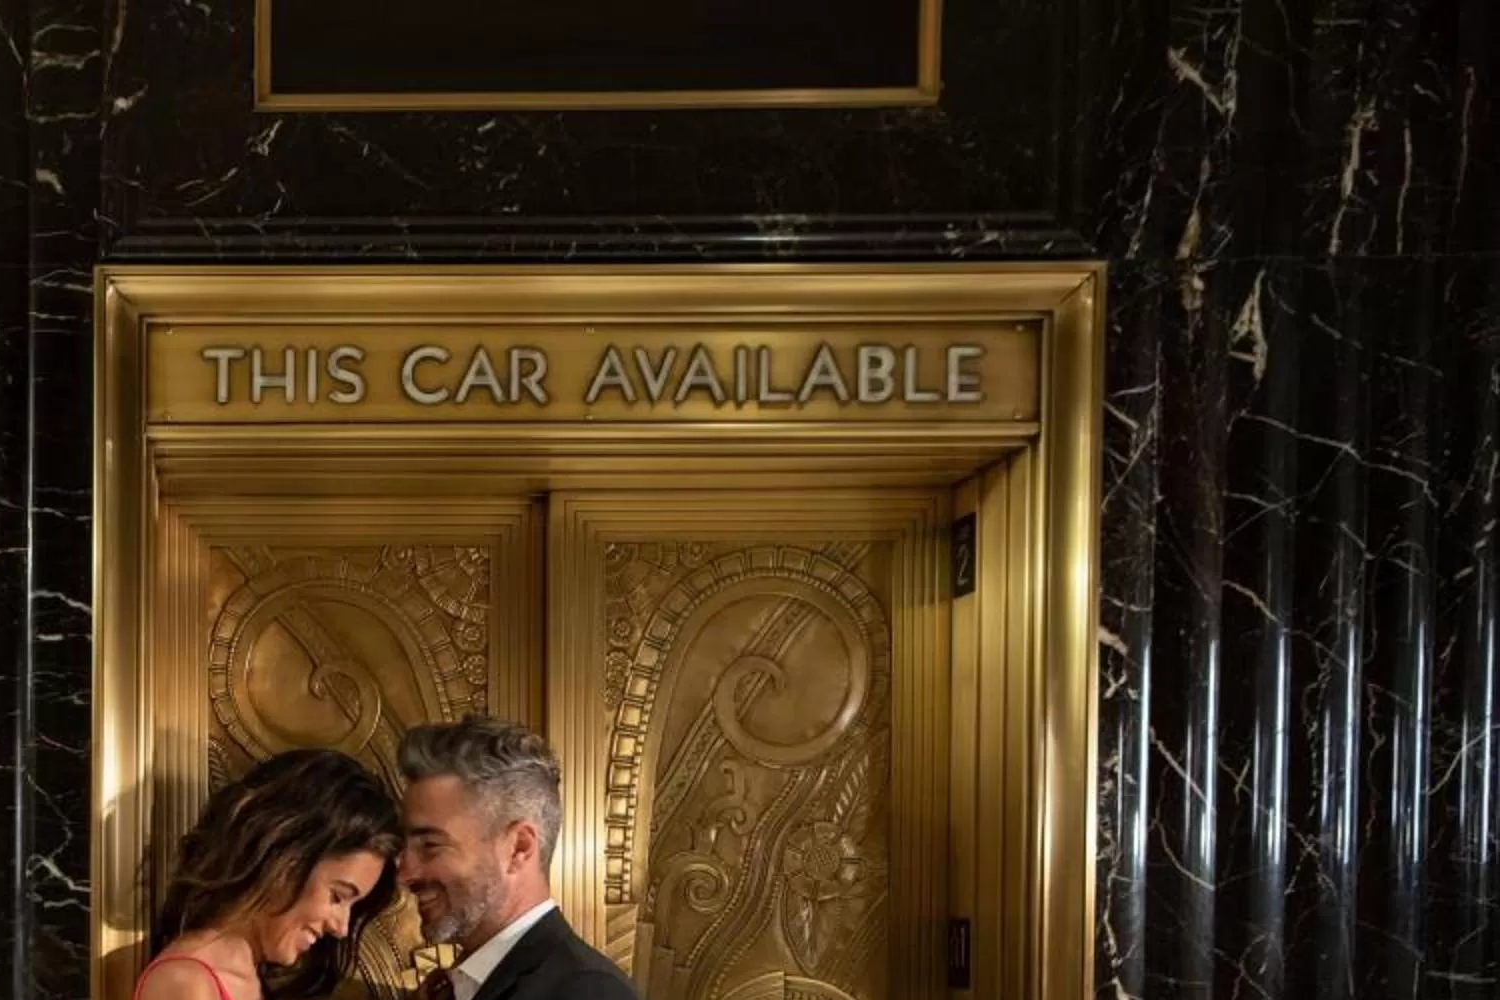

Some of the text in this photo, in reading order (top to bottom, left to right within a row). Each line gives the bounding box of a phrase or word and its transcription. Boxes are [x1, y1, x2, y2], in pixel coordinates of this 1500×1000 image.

[203, 345, 985, 404] THIS CAR AVAILABLE
